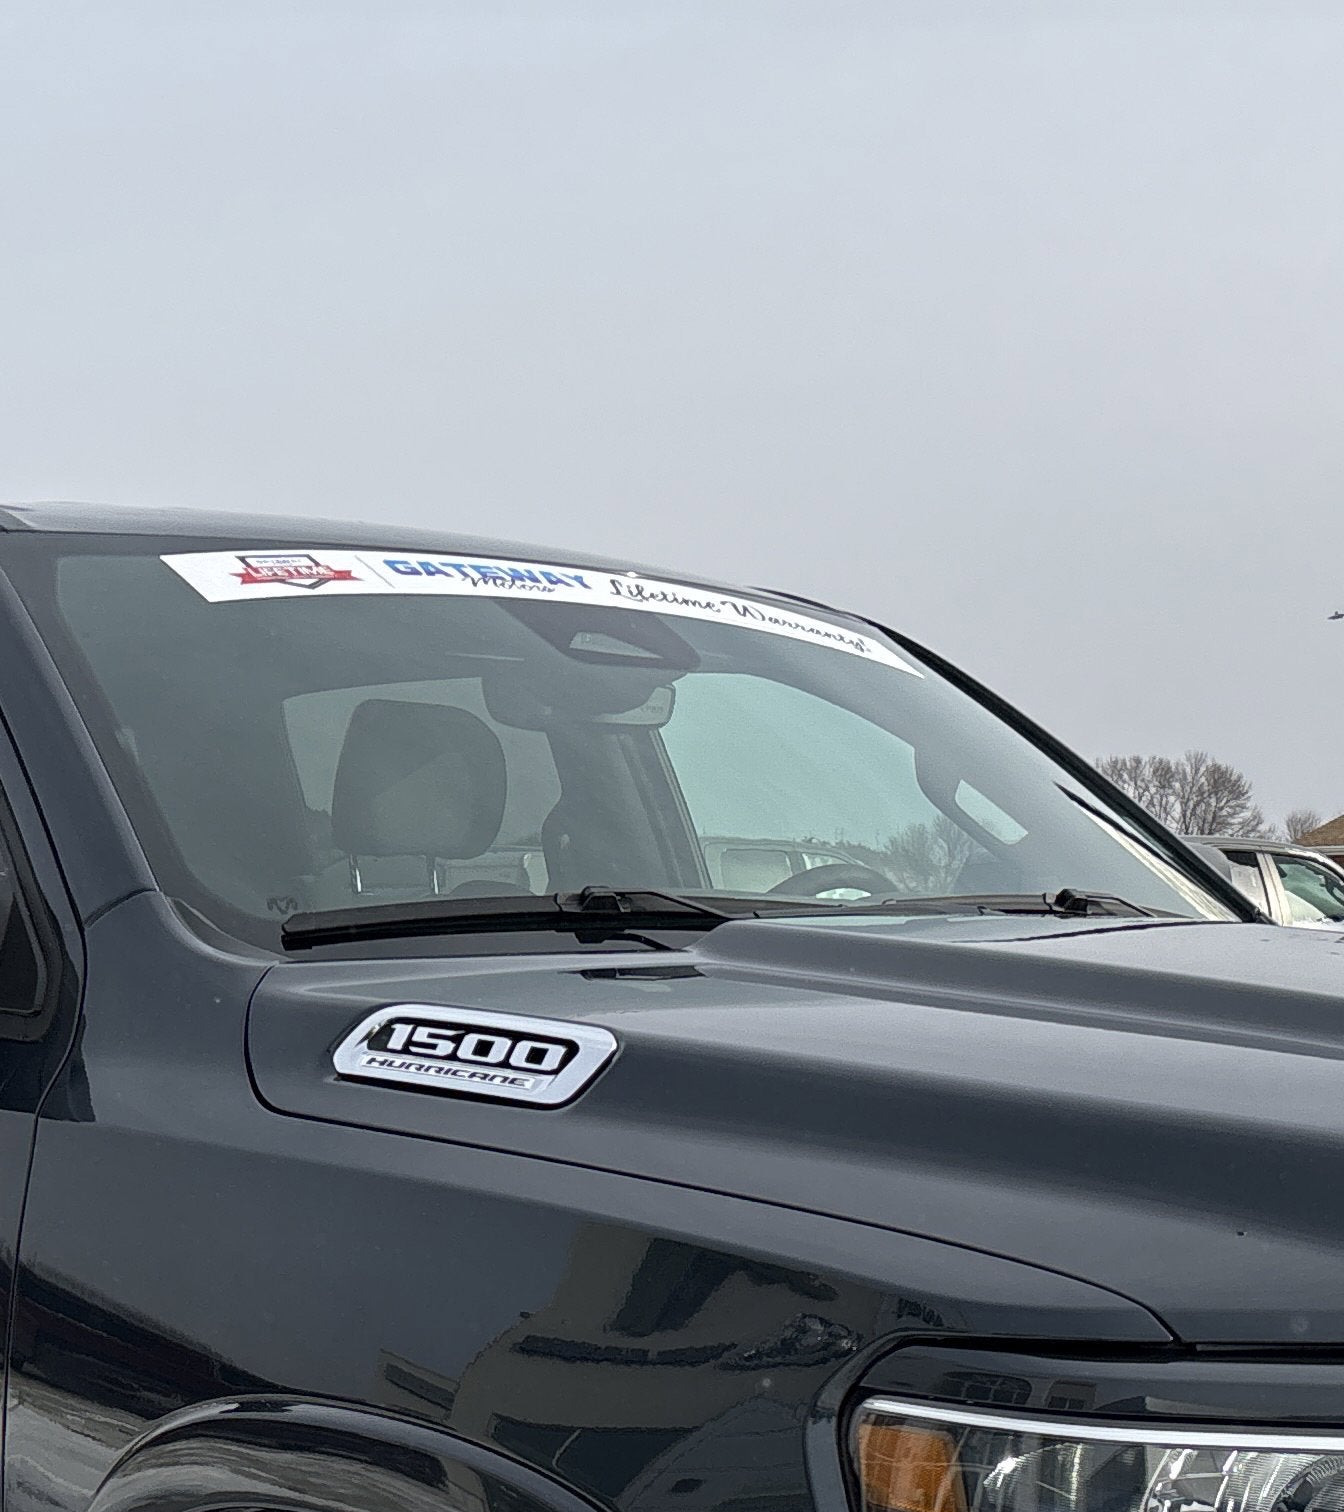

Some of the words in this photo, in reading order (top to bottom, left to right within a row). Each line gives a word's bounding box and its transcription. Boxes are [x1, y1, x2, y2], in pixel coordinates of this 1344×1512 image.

[246, 565, 335, 580] LIFETIME
[383, 559, 592, 590] GATEWAY
[609, 578, 722, 613] Lifetime
[386, 1023, 568, 1072] 1500
[365, 1056, 530, 1087] HURRICANE
